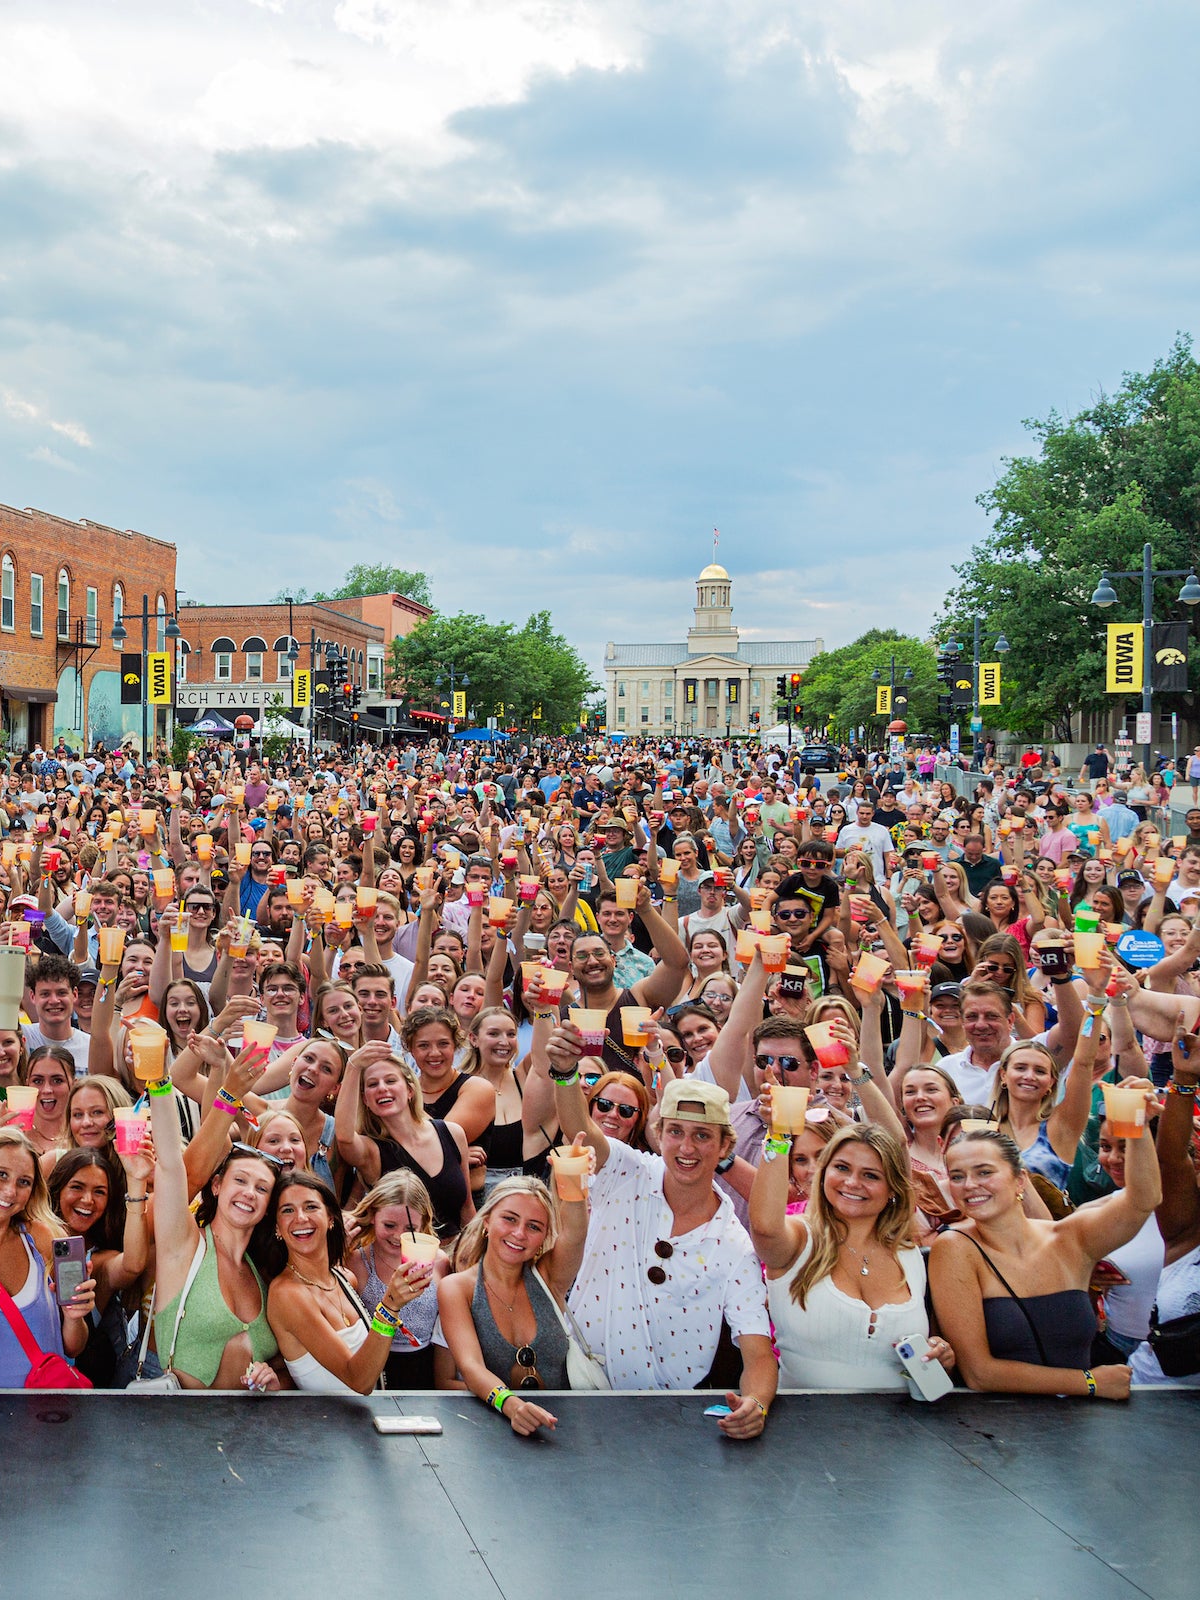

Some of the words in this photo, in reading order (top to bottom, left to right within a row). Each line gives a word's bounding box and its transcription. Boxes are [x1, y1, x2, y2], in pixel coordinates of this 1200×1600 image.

[1115, 632, 1134, 684] IOWA
[153, 658, 166, 698] IOWA
[297, 674, 307, 702] IOWA
[984, 668, 995, 700] IOWA
[216, 691, 285, 704] TAVERN
[880, 690, 888, 711] IOWA
